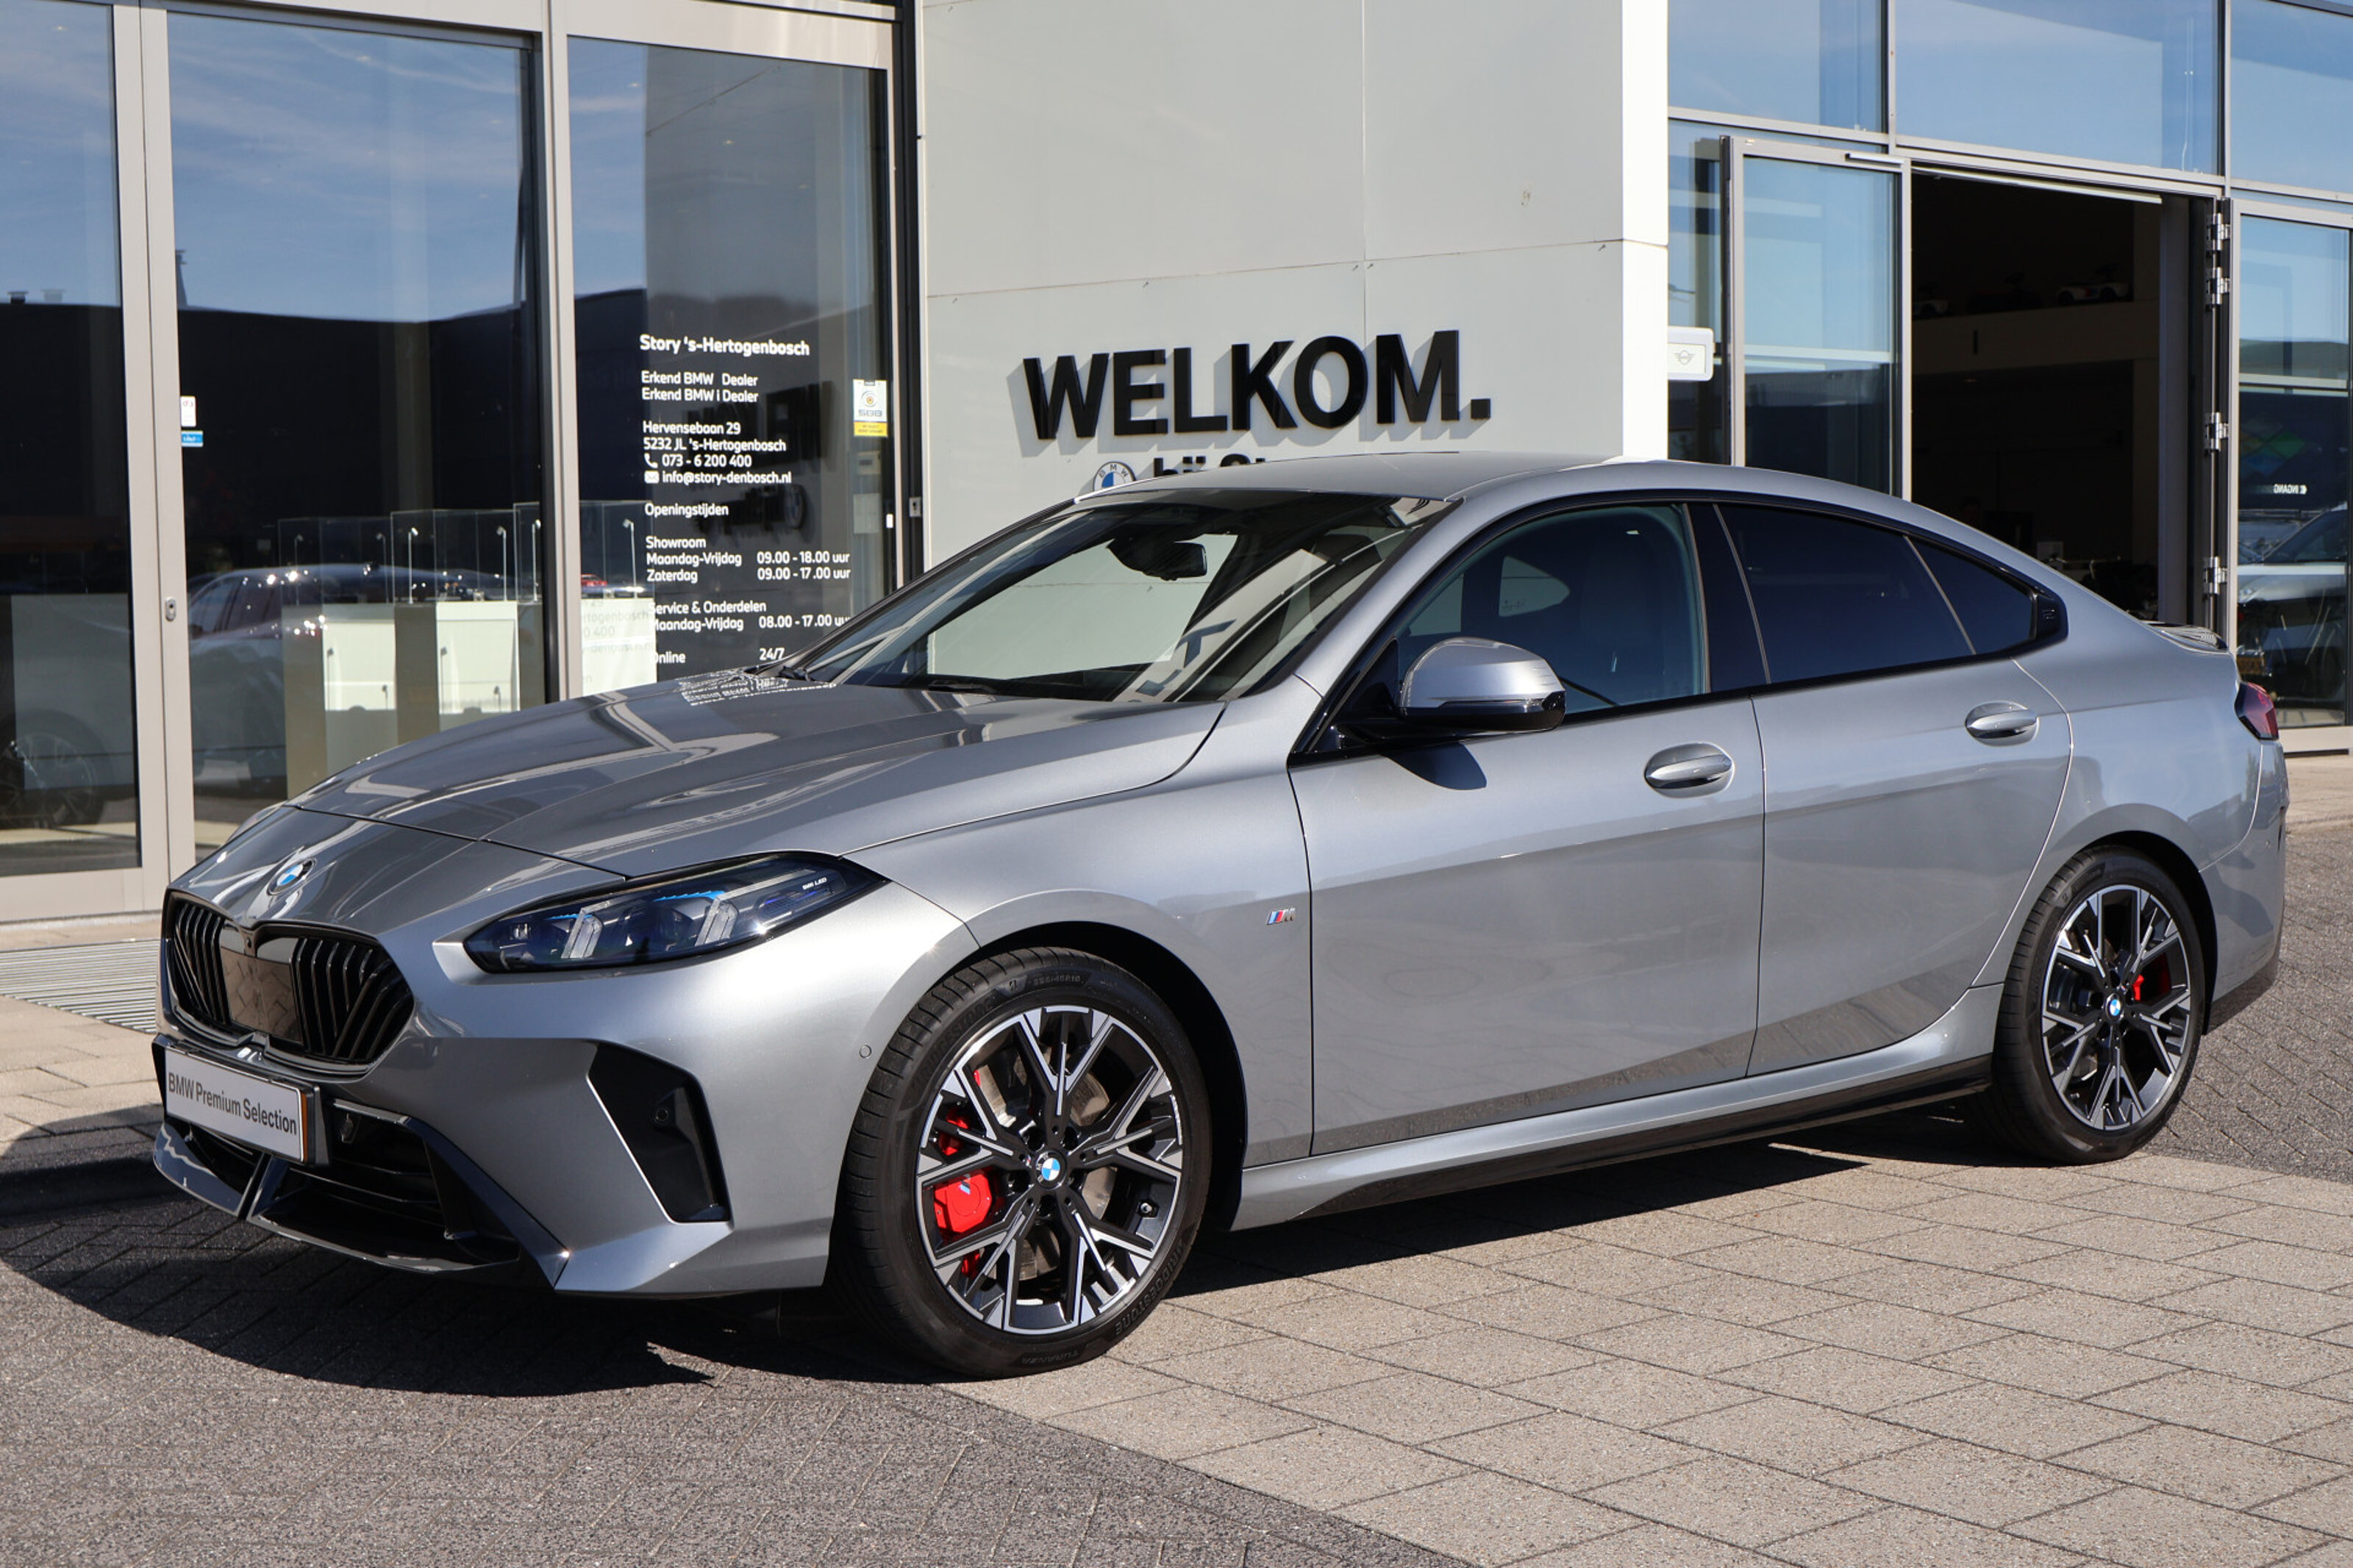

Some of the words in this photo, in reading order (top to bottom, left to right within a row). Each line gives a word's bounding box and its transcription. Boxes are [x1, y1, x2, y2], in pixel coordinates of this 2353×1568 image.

[640, 334, 681, 354] Story
[684, 336, 810, 357] 's-Hertogenbosch
[642, 370, 681, 384] Erkend
[684, 372, 714, 385] BMW
[722, 373, 758, 387] Dealer
[1023, 330, 1492, 440] WELKOM.
[642, 387, 682, 401] Erkend
[685, 389, 714, 402] BMW
[717, 390, 720, 402] i
[723, 390, 759, 403] Dealer
[643, 420, 724, 435] Hervensebaan
[726, 422, 740, 435] 29
[643, 437, 672, 451] 5232
[674, 438, 687, 451] JL
[689, 439, 787, 454] 's-Hertogenbosch
[662, 454, 683, 467] 073
[694, 454, 701, 468] 6
[704, 454, 726, 468] 200
[729, 454, 751, 468] 400
[663, 470, 792, 486] info@story-denbosch.nl
[644, 503, 729, 518] Openingstijden
[646, 536, 706, 548] Showroom
[646, 552, 742, 568] Maandag-Vrijdag
[757, 551, 790, 565] 09.00
[799, 551, 830, 564] 18.00
[832, 554, 850, 563] uur
[647, 569, 698, 584] Zaterdag
[757, 567, 790, 580] 09.00
[833, 570, 851, 579] uur
[692, 601, 701, 614] &
[704, 600, 766, 613] Onderdelen
[759, 615, 793, 629] 08.00
[760, 648, 785, 661] 24/7
[168, 1072, 195, 1100] BMW
[196, 1083, 241, 1117] Premium
[243, 1098, 298, 1136] Selection
